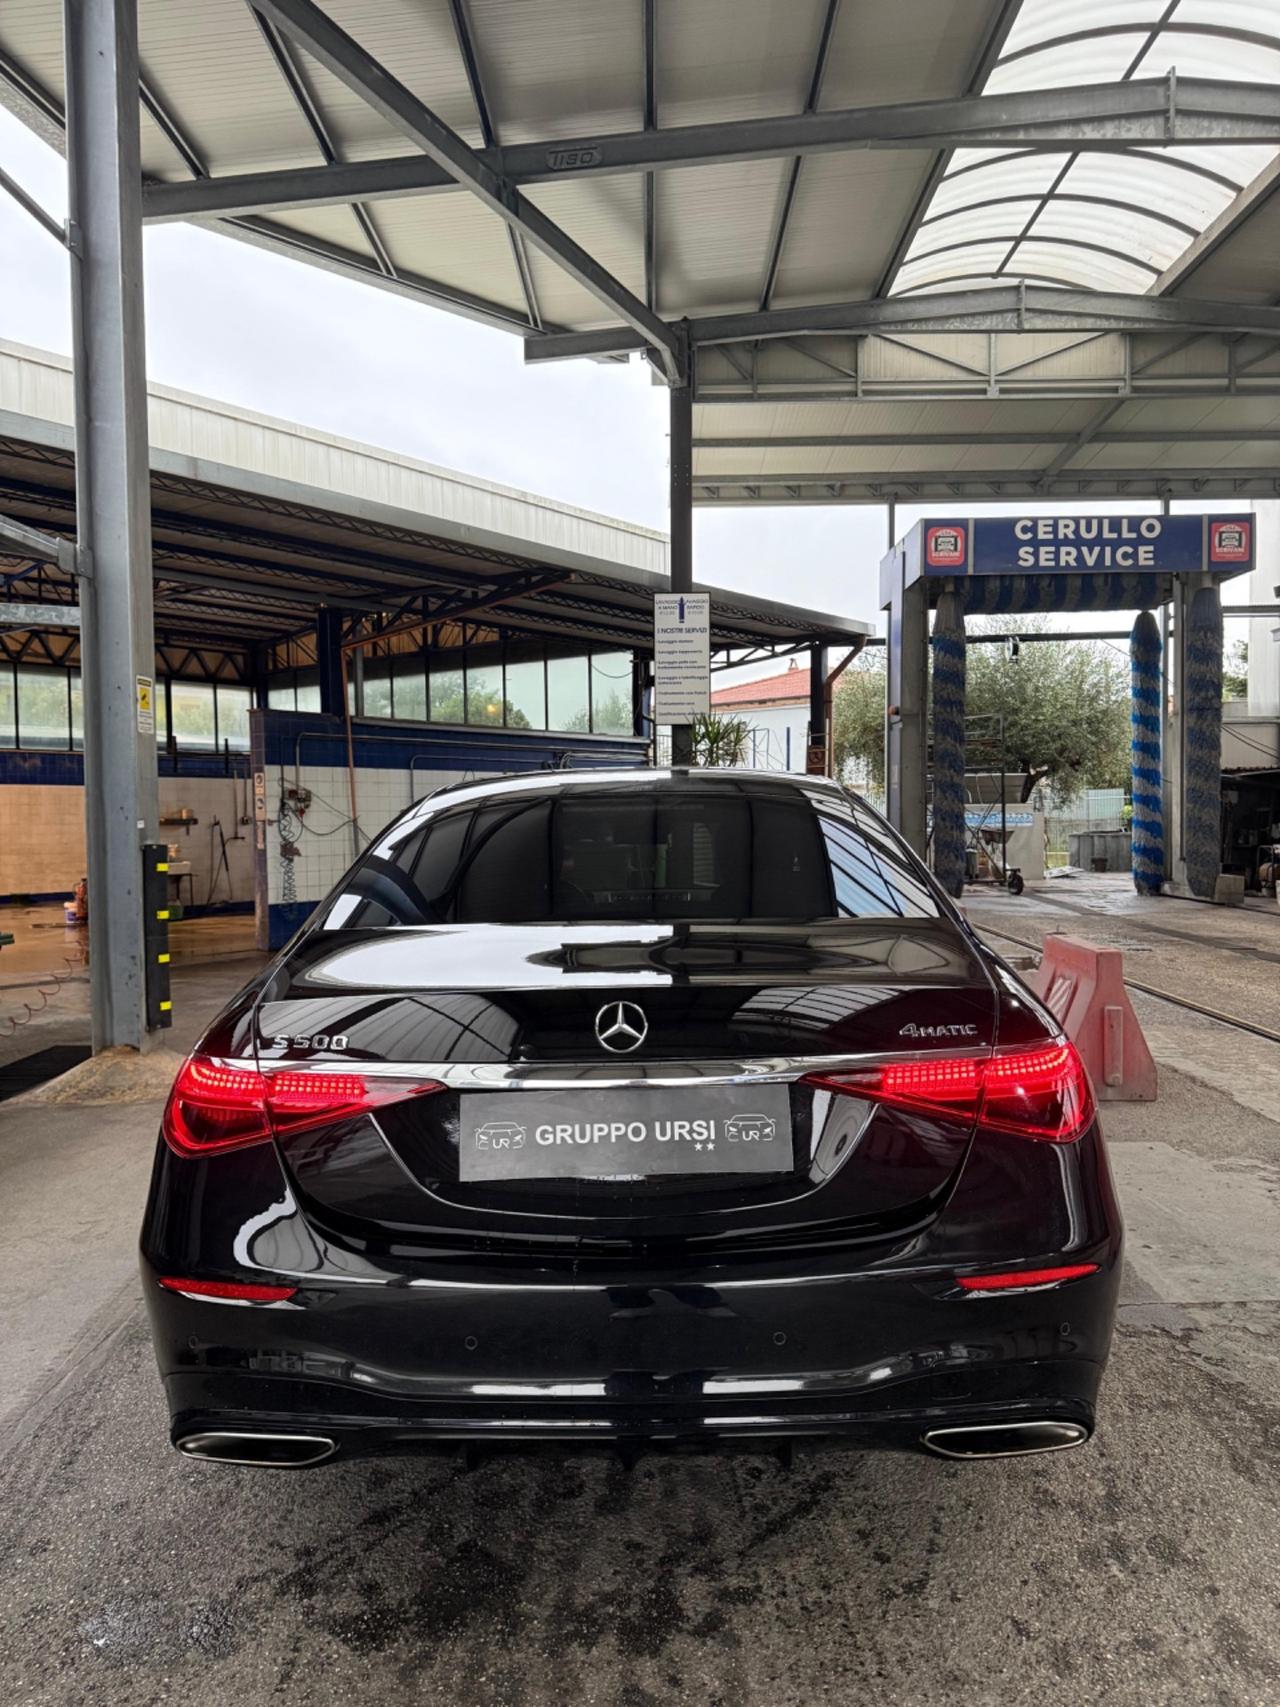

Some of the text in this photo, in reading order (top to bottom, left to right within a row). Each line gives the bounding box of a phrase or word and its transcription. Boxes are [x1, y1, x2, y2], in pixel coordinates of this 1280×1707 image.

[1014, 518, 1162, 540] CERULLO
[1017, 545, 1155, 567] SERVICE
[899, 1023, 978, 1037] 4MATIC
[272, 1034, 349, 1050] S 500
[535, 1119, 716, 1145] GRUPPO URSI
[742, 1130, 760, 1141] UR
[492, 1138, 510, 1149] UR
